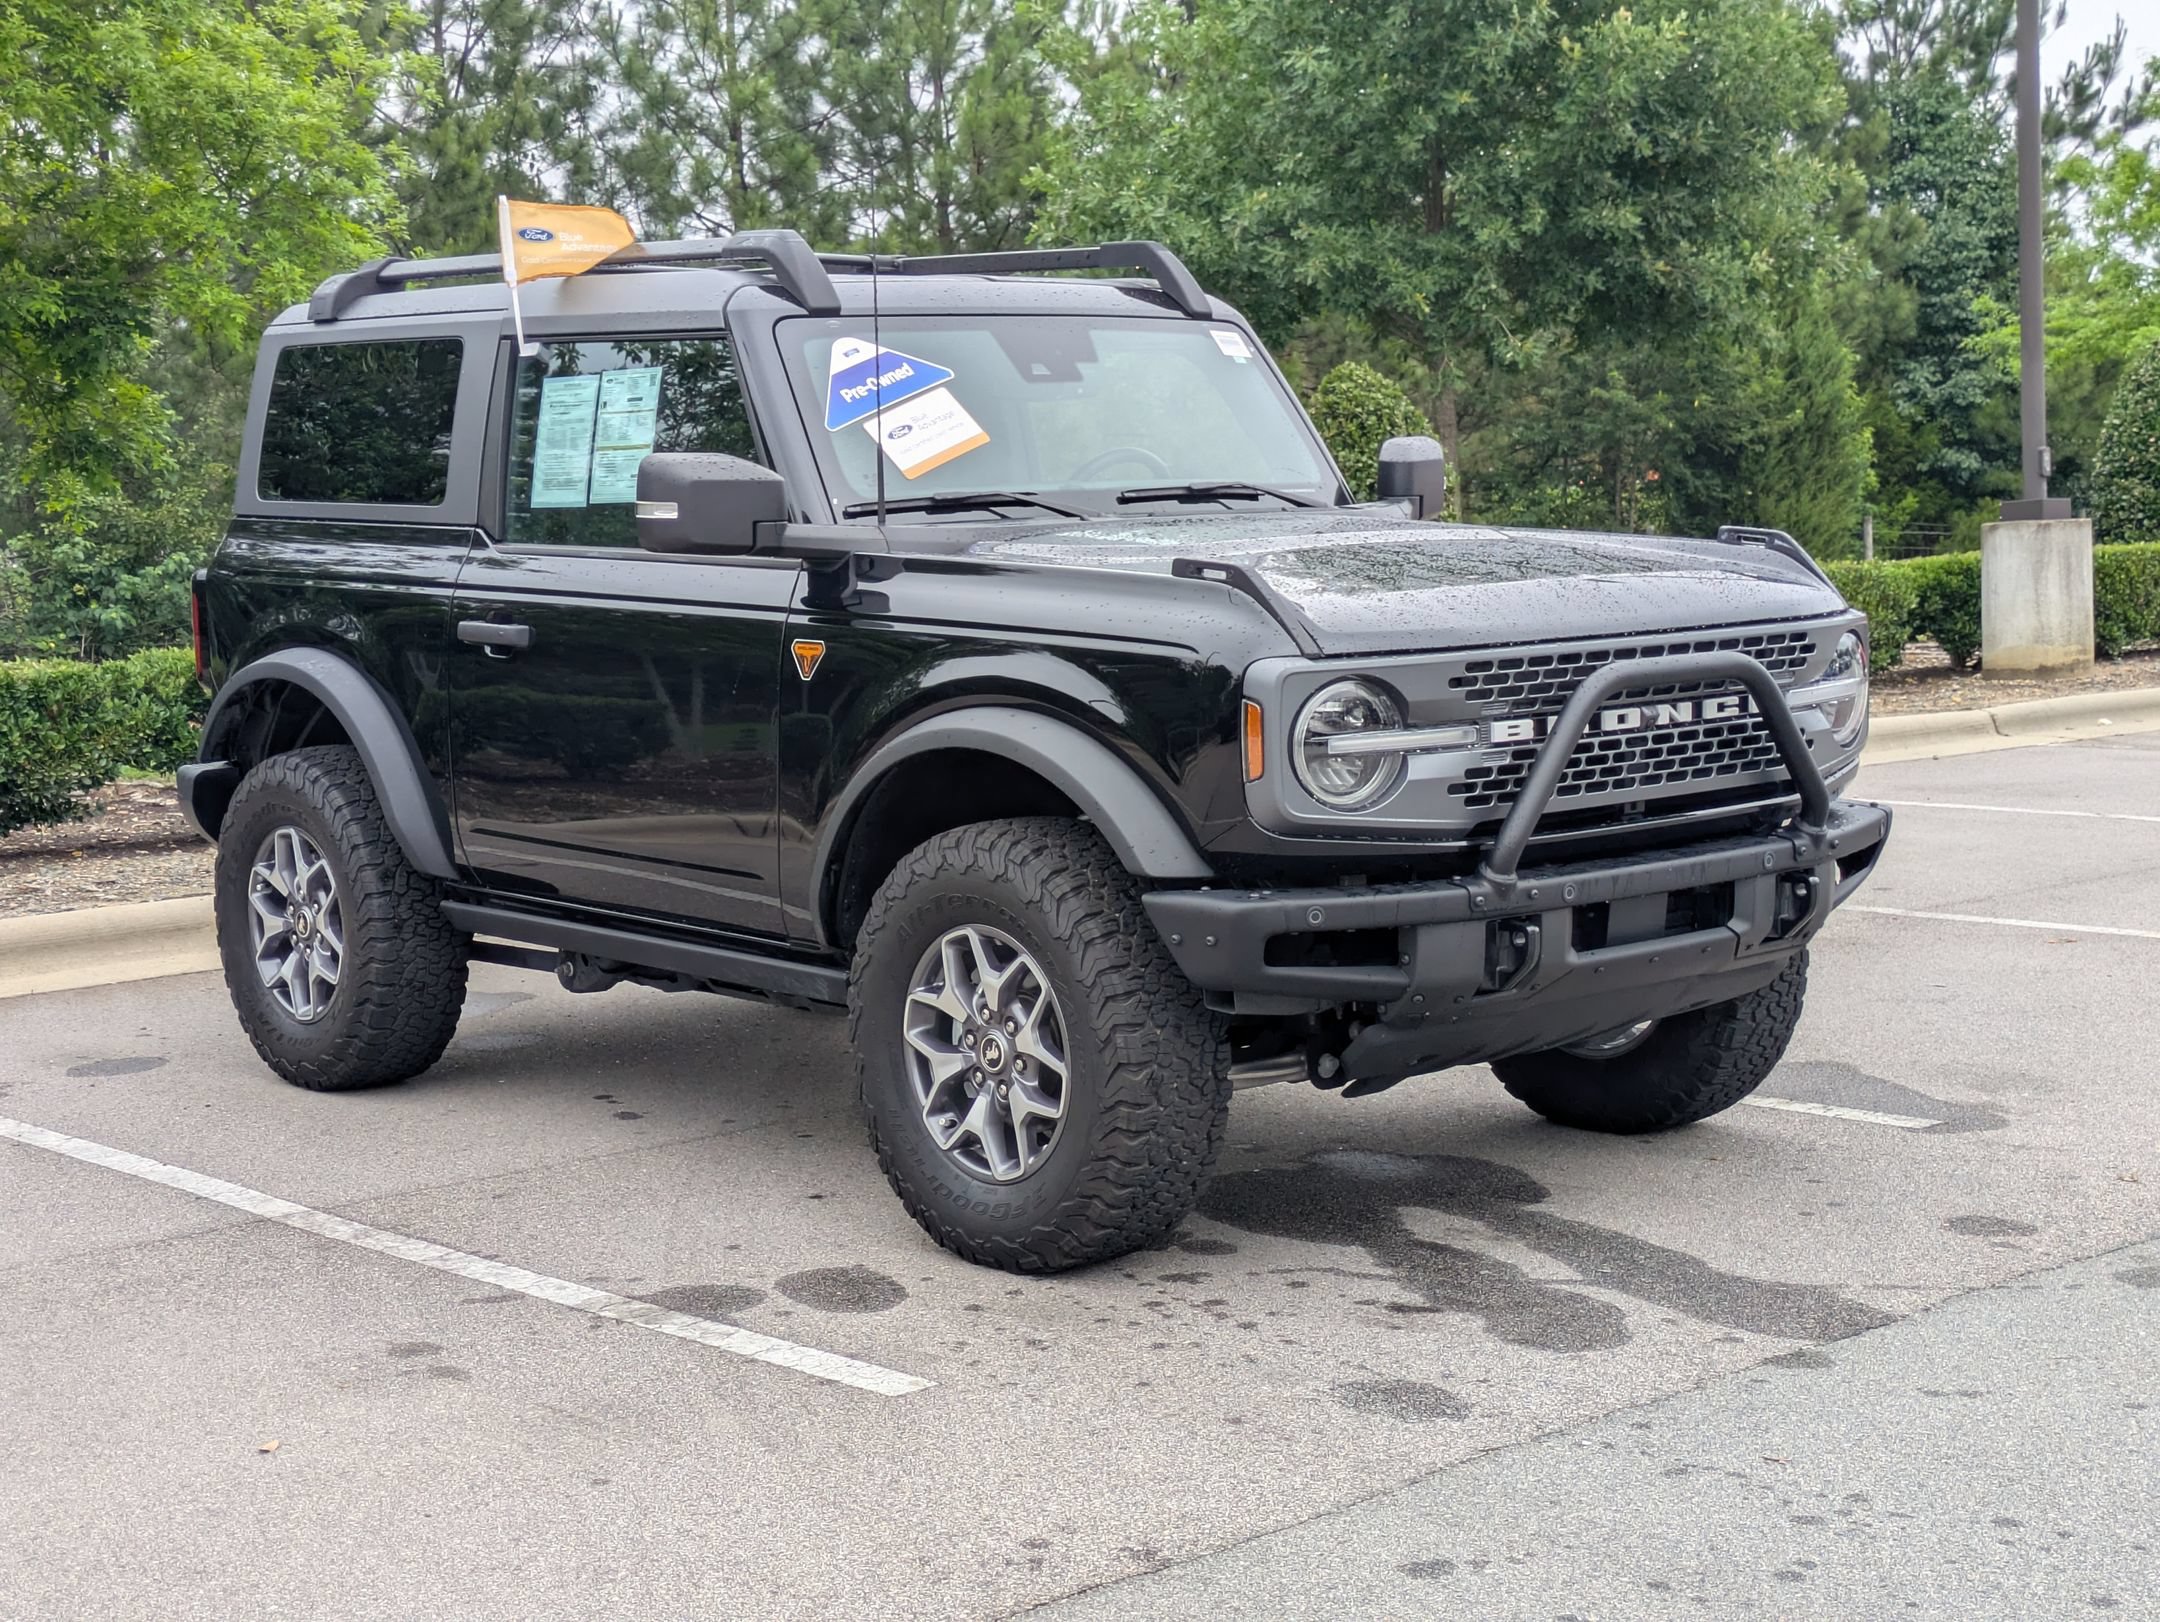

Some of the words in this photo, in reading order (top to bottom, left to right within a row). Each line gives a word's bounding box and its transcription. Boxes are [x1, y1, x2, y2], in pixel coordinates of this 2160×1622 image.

[522, 228, 551, 241] Ford
[840, 362, 915, 403] Pre-Owned
[1490, 694, 1760, 742] BONC
